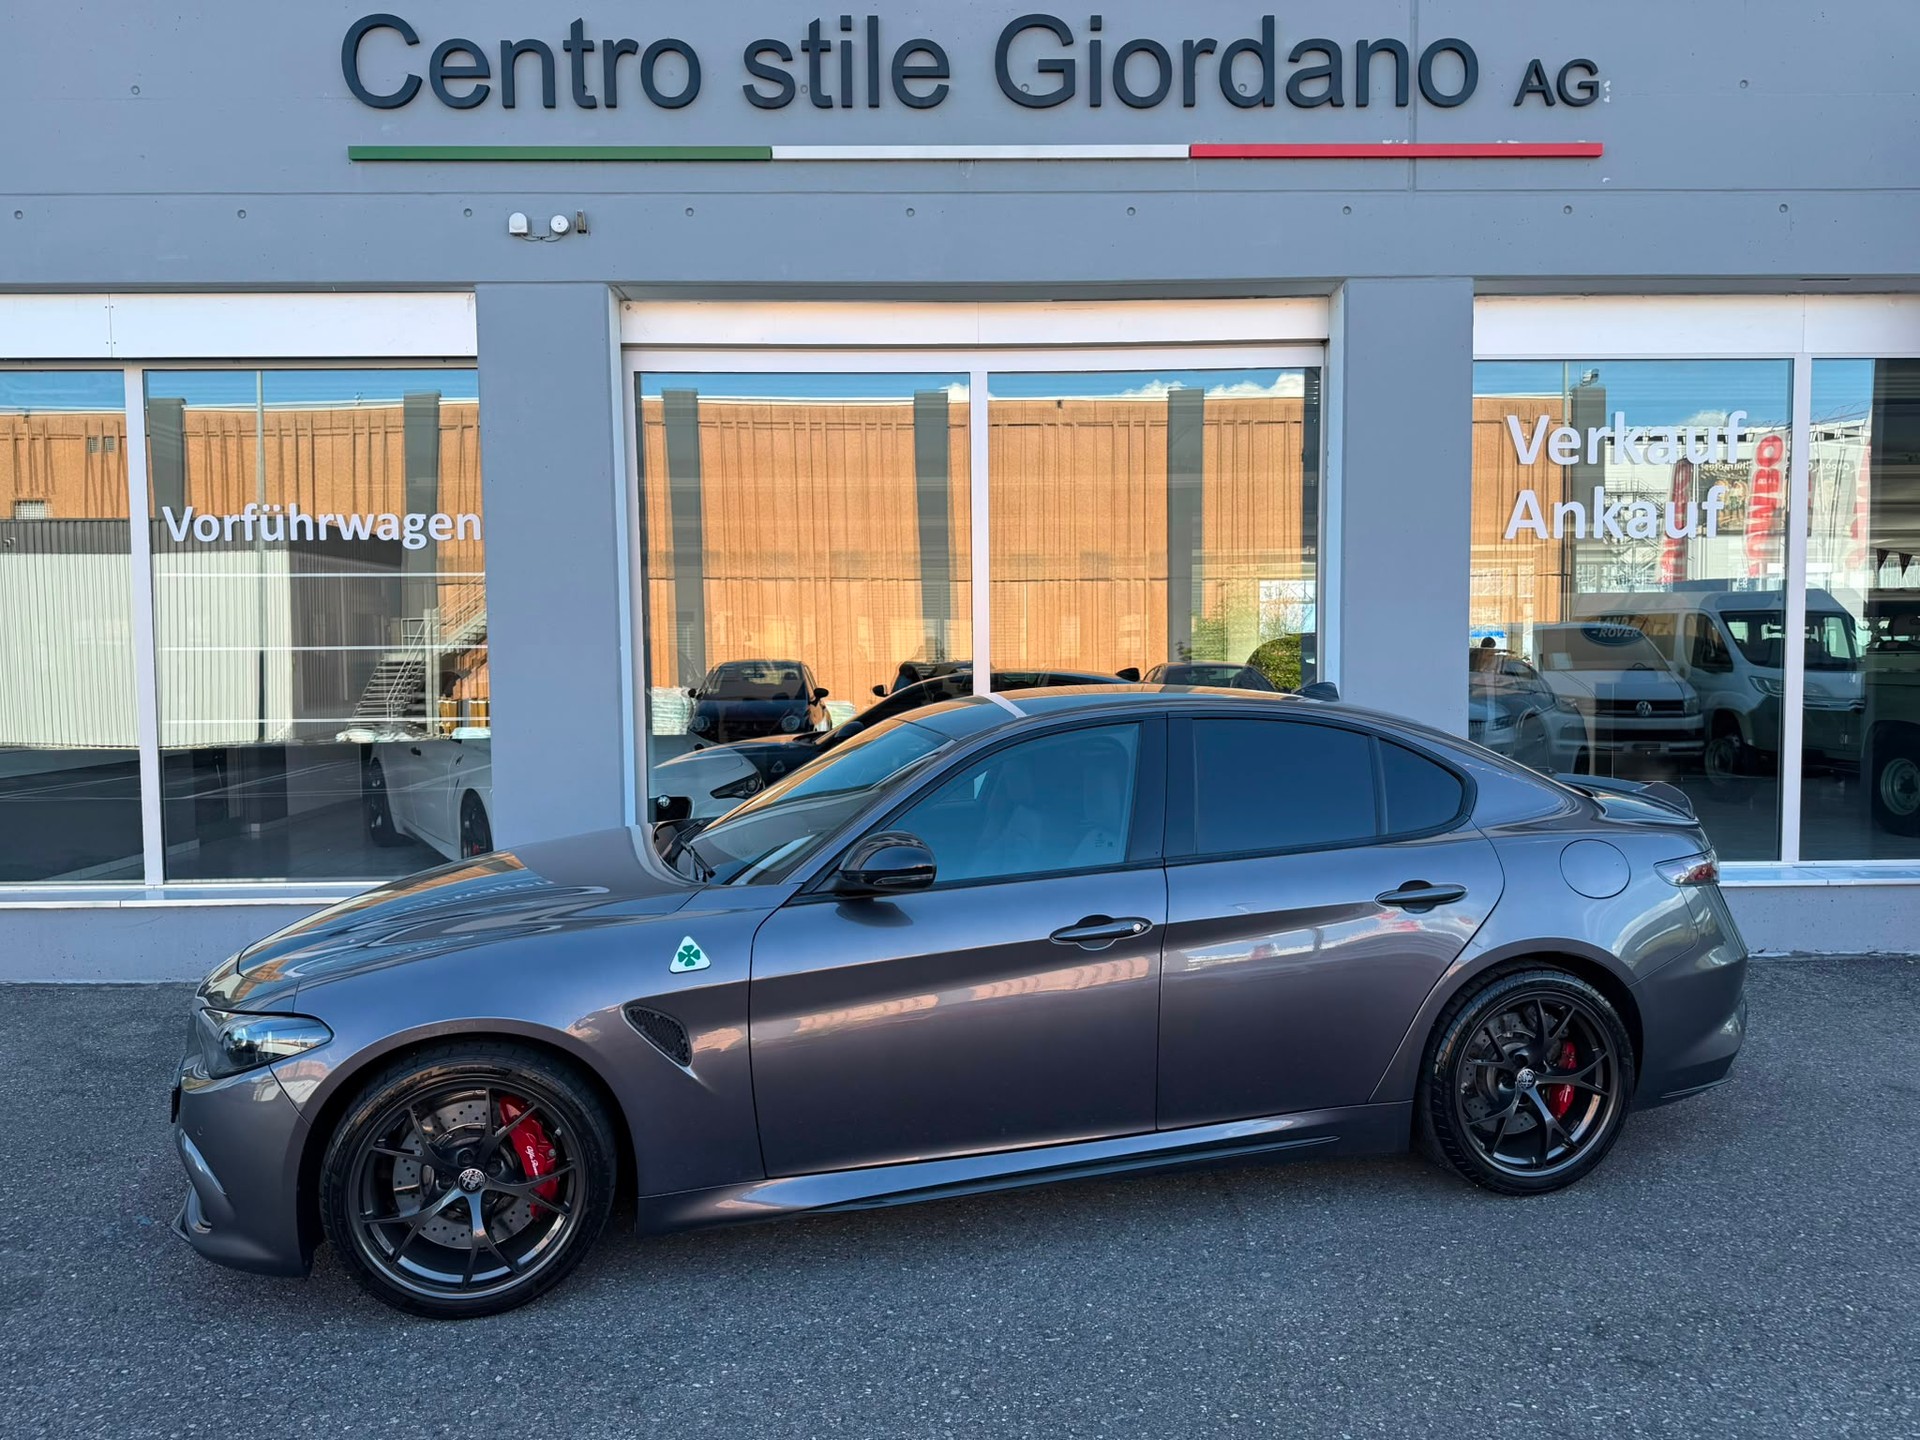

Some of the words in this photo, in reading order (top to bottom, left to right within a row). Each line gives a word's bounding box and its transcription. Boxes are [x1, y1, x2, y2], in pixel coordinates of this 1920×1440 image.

[341, 13, 701, 110] Centro
[743, 15, 950, 110] stile
[994, 14, 1479, 109] Giordano
[1513, 58, 1600, 107] AG
[1507, 410, 1748, 465] Verkauf
[162, 503, 482, 549] Vorführwagen
[1504, 485, 1726, 540] Ankauf
[1598, 627, 1639, 638] ROVER
